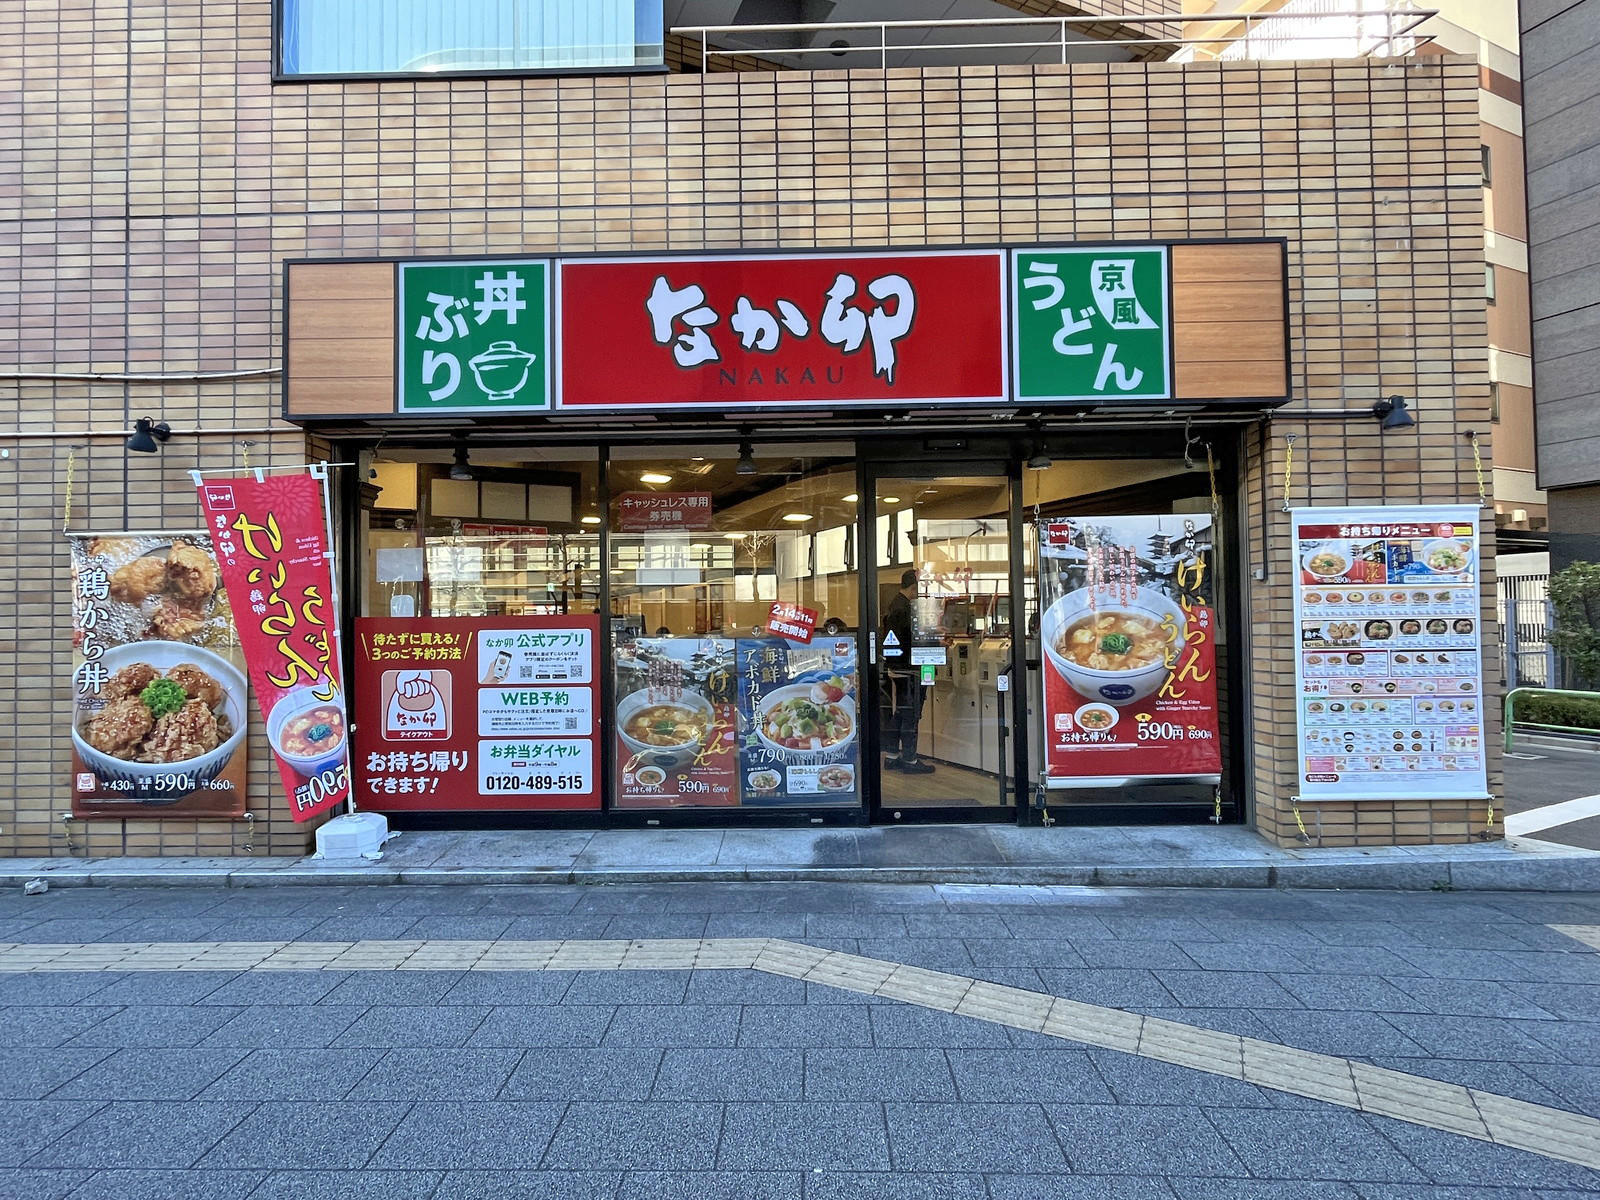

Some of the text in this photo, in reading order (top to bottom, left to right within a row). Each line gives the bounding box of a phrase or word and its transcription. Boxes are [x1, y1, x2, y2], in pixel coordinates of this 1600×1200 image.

[473, 271, 527, 326] 丼
[1098, 263, 1140, 326] 京風
[645, 272, 916, 384] なか卯
[1023, 261, 1144, 391] うどん
[415, 291, 470, 402] ぶり
[719, 366, 845, 385] NAKAU
[623, 496, 709, 509] キャッシュレス専用
[649, 510, 683, 521] 券売機
[1339, 525, 1431, 537] お持ち帰りメニュー
[1177, 556, 1211, 682] けいらん
[77, 567, 112, 695] 鶏から丼
[769, 620, 809, 639] 販売開始
[373, 632, 461, 646] 待たずに買える!
[485, 632, 585, 649] なか卯 公式アプリ
[372, 647, 462, 660] 3つのご予約方法
[1158, 613, 1187, 699] うどん
[760, 646, 781, 684] 海鮮
[743, 648, 767, 730] アボカド丼
[500, 691, 569, 706] WEB予約
[396, 711, 437, 727] なか卯
[1137, 722, 1184, 740] 590円
[490, 743, 581, 759] お弁当ダイヤル
[366, 750, 469, 772] お持ち帰り
[366, 777, 440, 794] できます!
[486, 775, 583, 790] 0120-489-515
[678, 780, 710, 793] 590円
